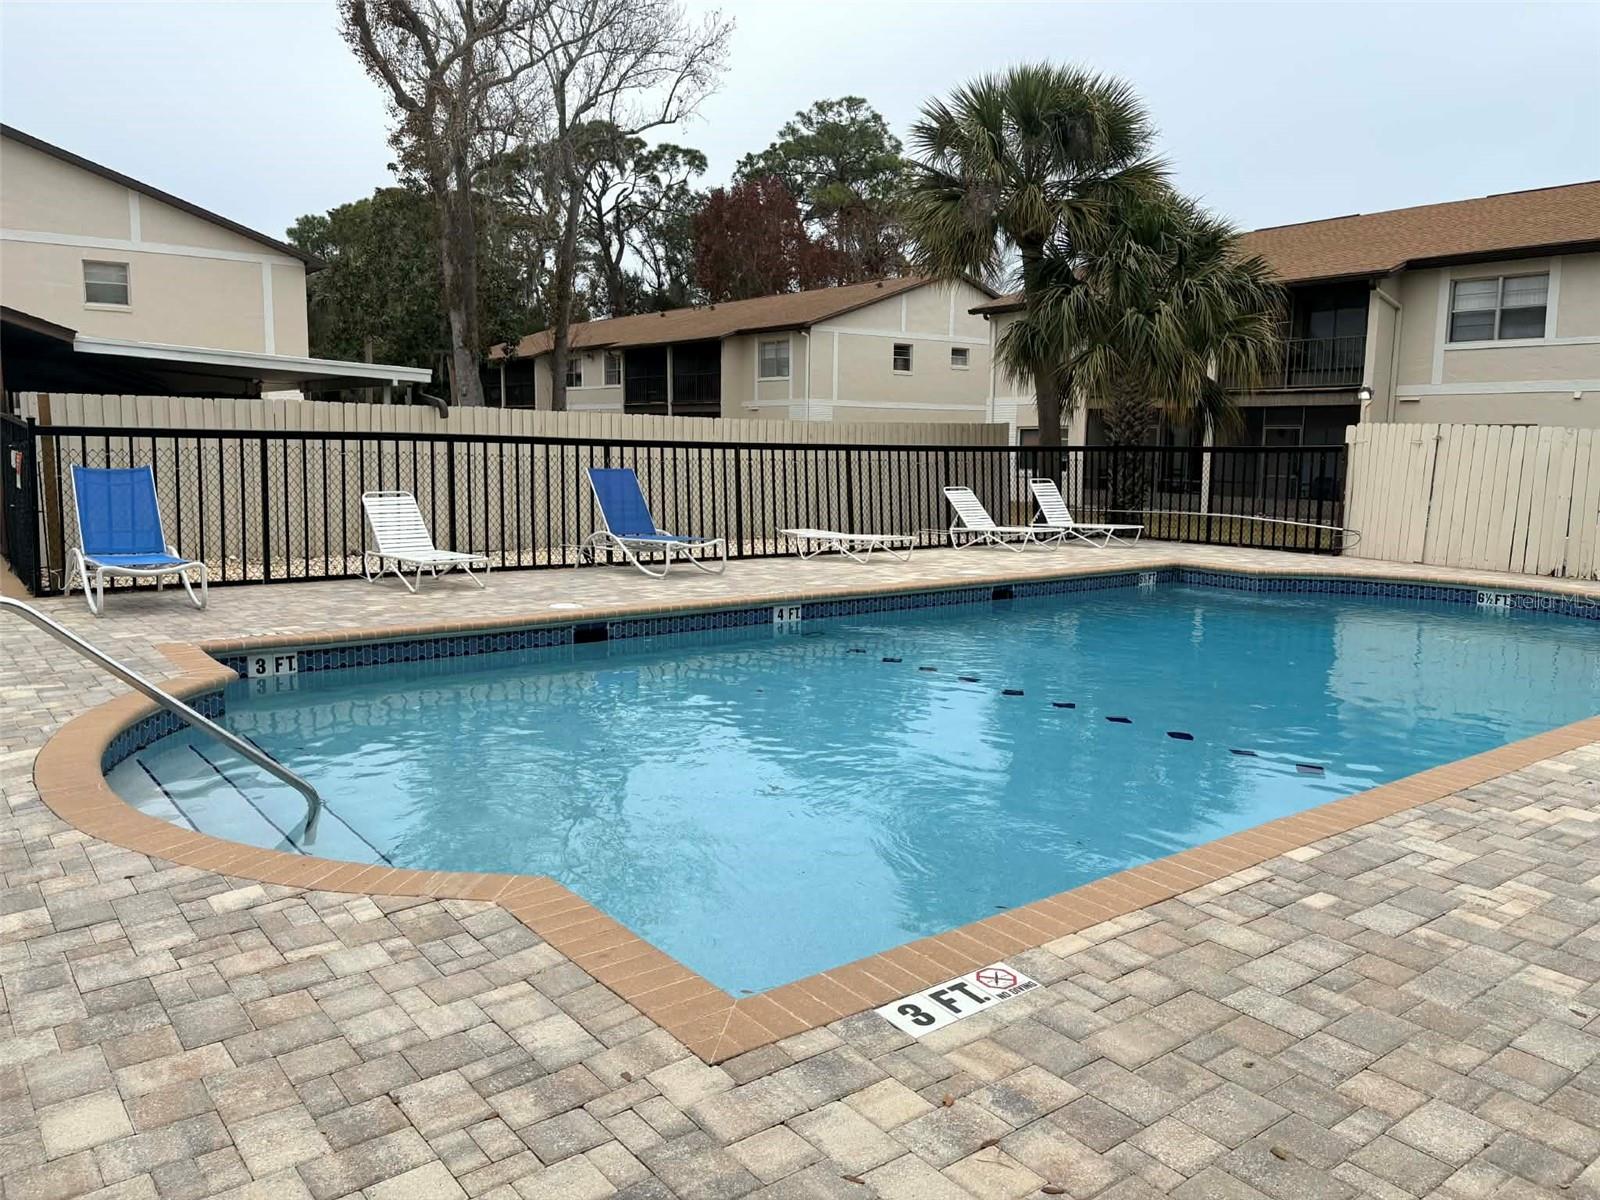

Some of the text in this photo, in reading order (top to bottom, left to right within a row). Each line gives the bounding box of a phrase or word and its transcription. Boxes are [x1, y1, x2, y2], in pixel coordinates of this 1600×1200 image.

[777, 608, 784, 621] 4
[255, 655, 296, 674] 3 FT.
[995, 980, 1038, 1000] NO DIVING
[897, 982, 991, 1026] 3 FT.
